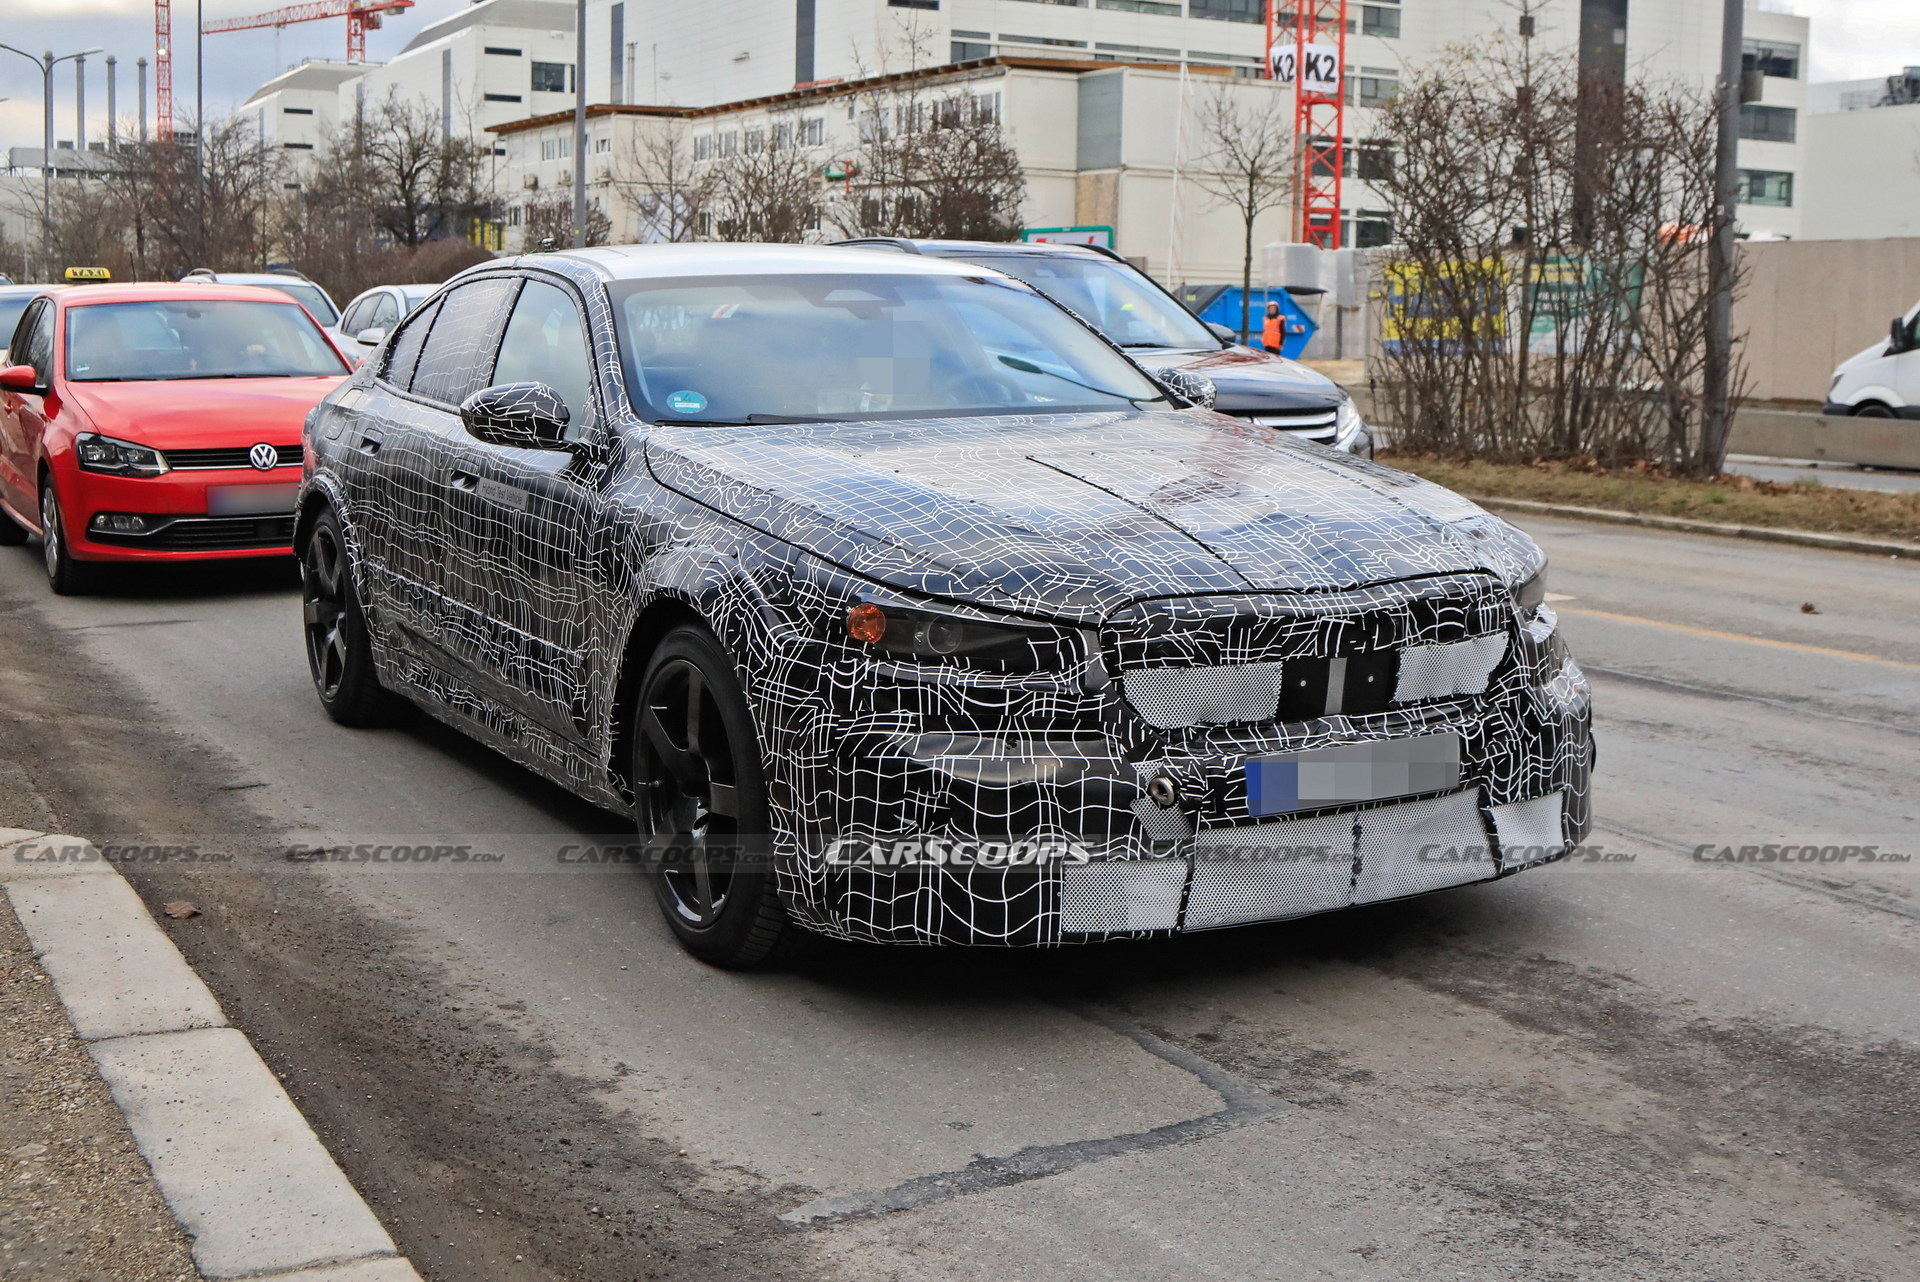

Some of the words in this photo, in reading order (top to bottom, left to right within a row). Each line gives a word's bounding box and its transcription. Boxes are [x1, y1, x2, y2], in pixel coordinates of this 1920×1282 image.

[1272, 53, 1295, 82] K2
[1305, 52, 1336, 82] K2
[72, 268, 105, 277] TAXI
